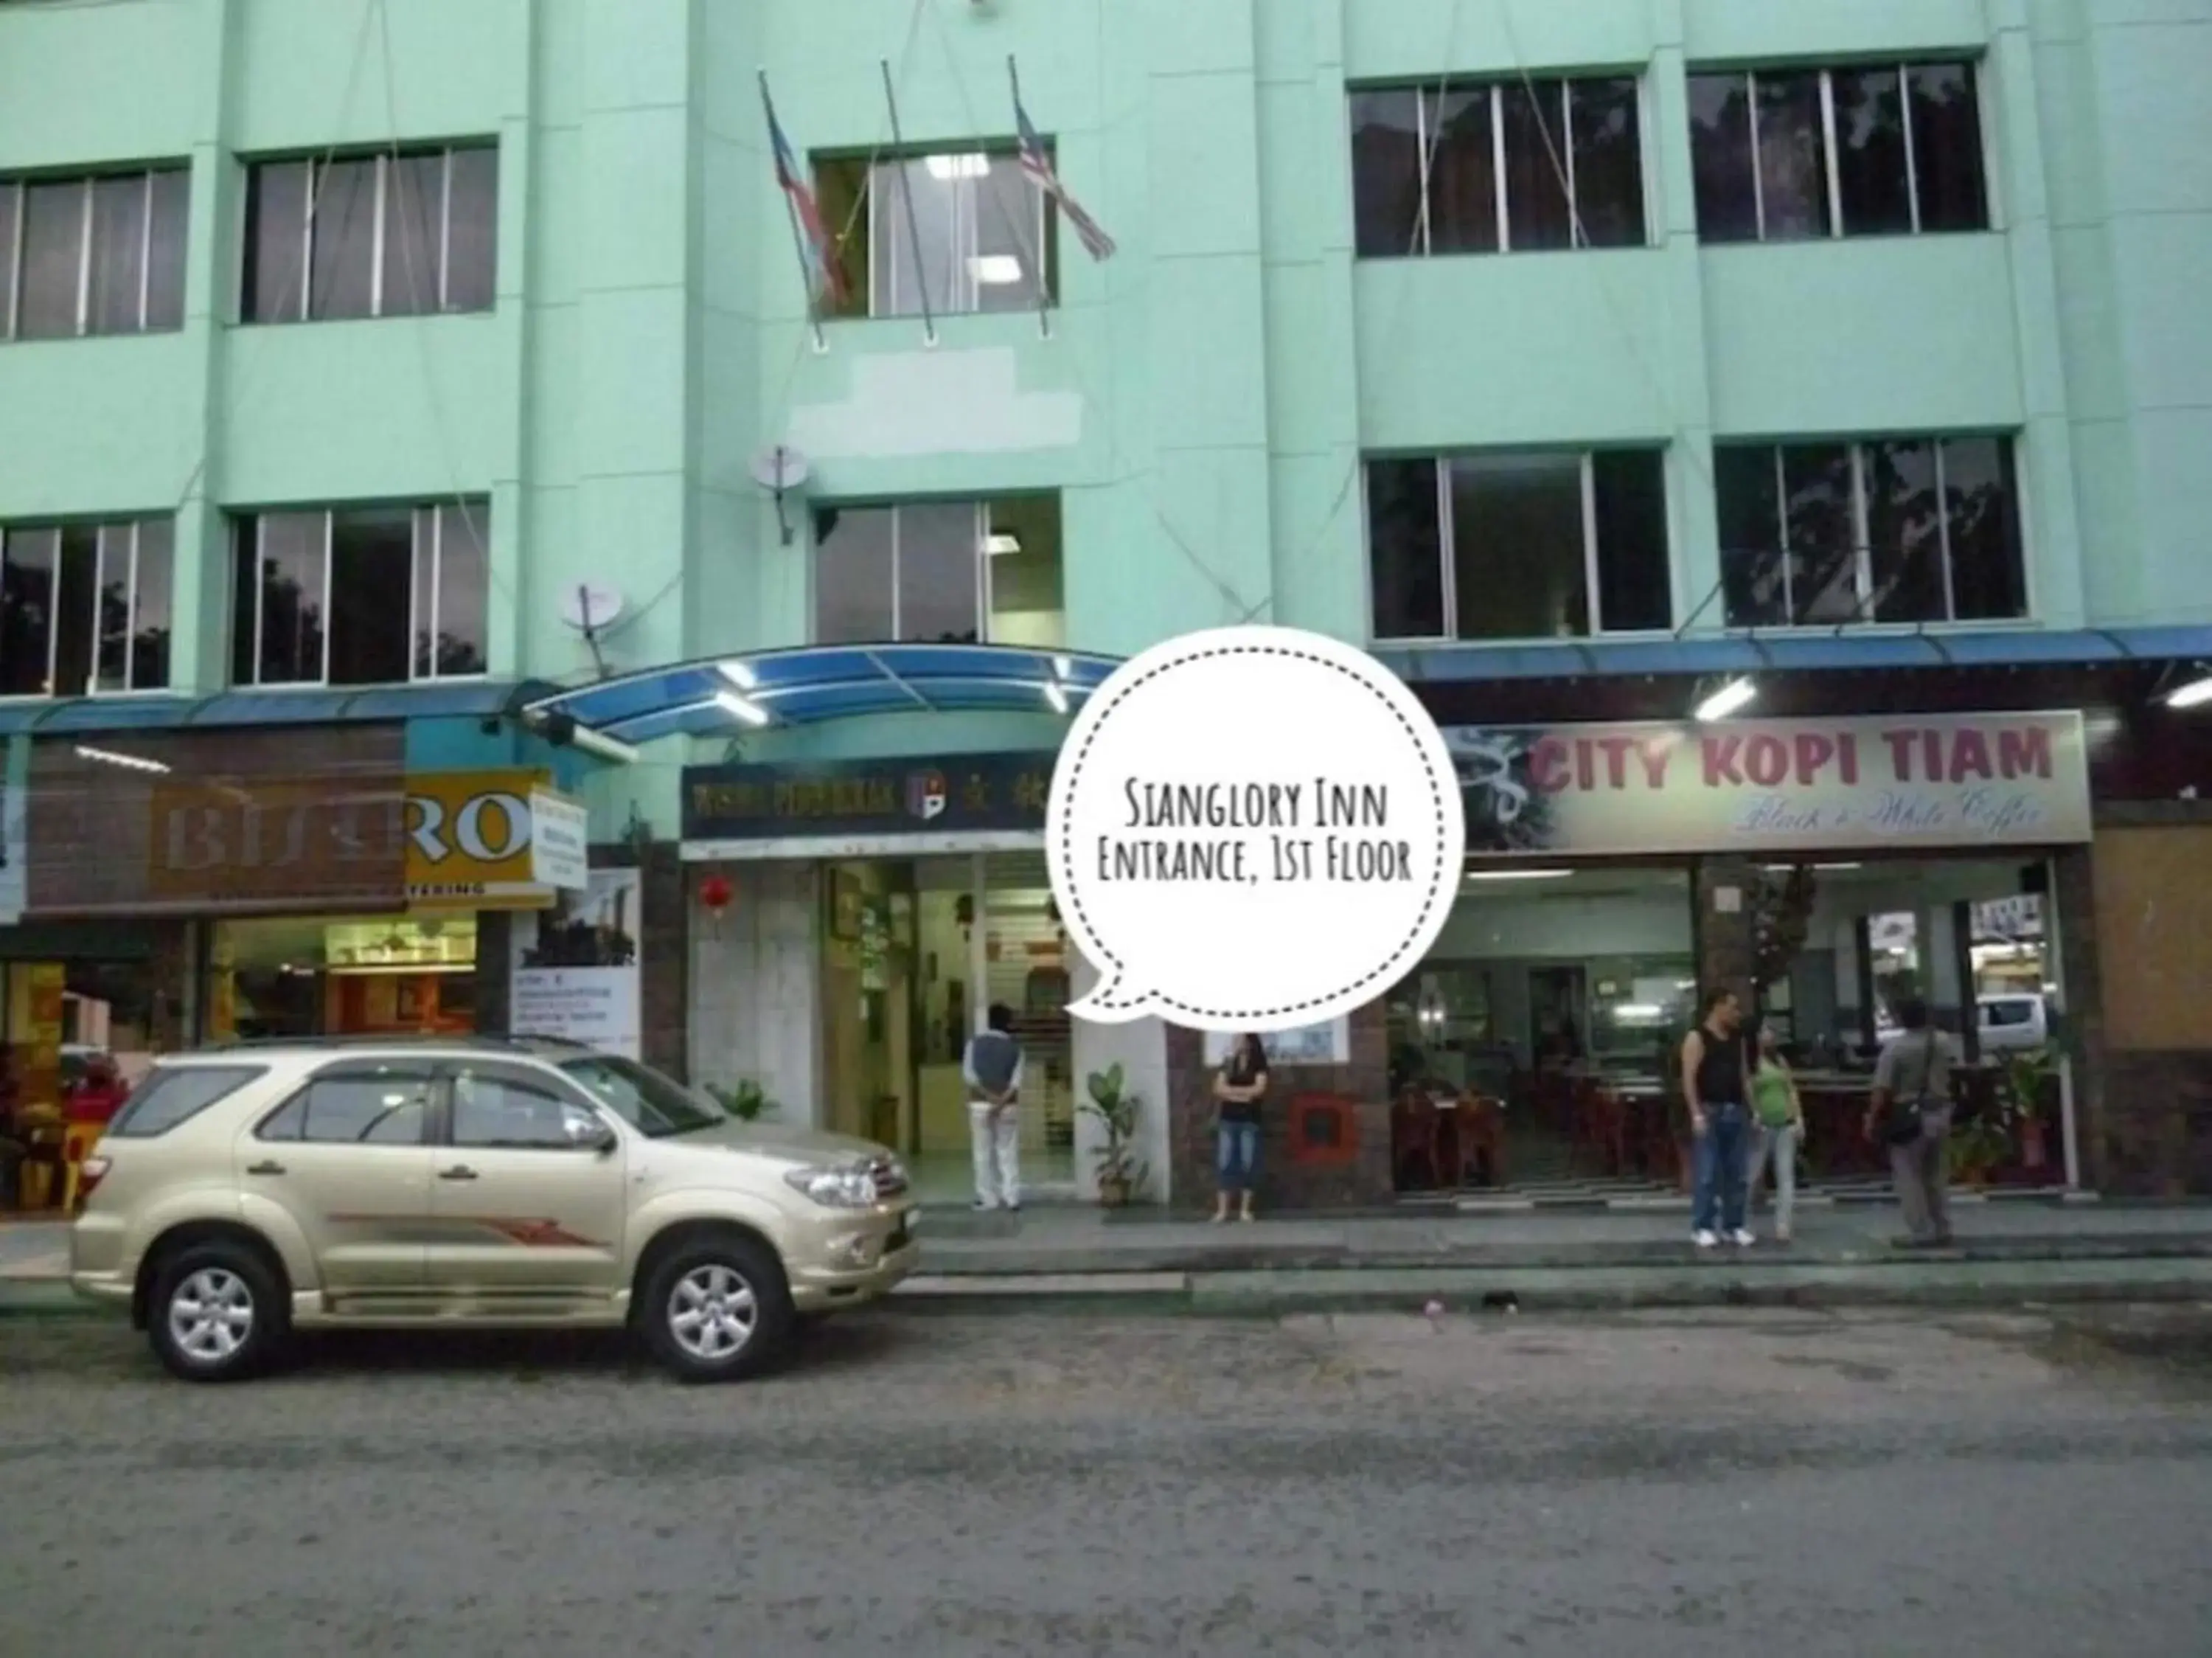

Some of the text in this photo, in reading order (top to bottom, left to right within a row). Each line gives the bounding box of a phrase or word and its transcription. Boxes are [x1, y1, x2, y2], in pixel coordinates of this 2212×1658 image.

[1526, 726, 2053, 792] CITY KOPI TIAM
